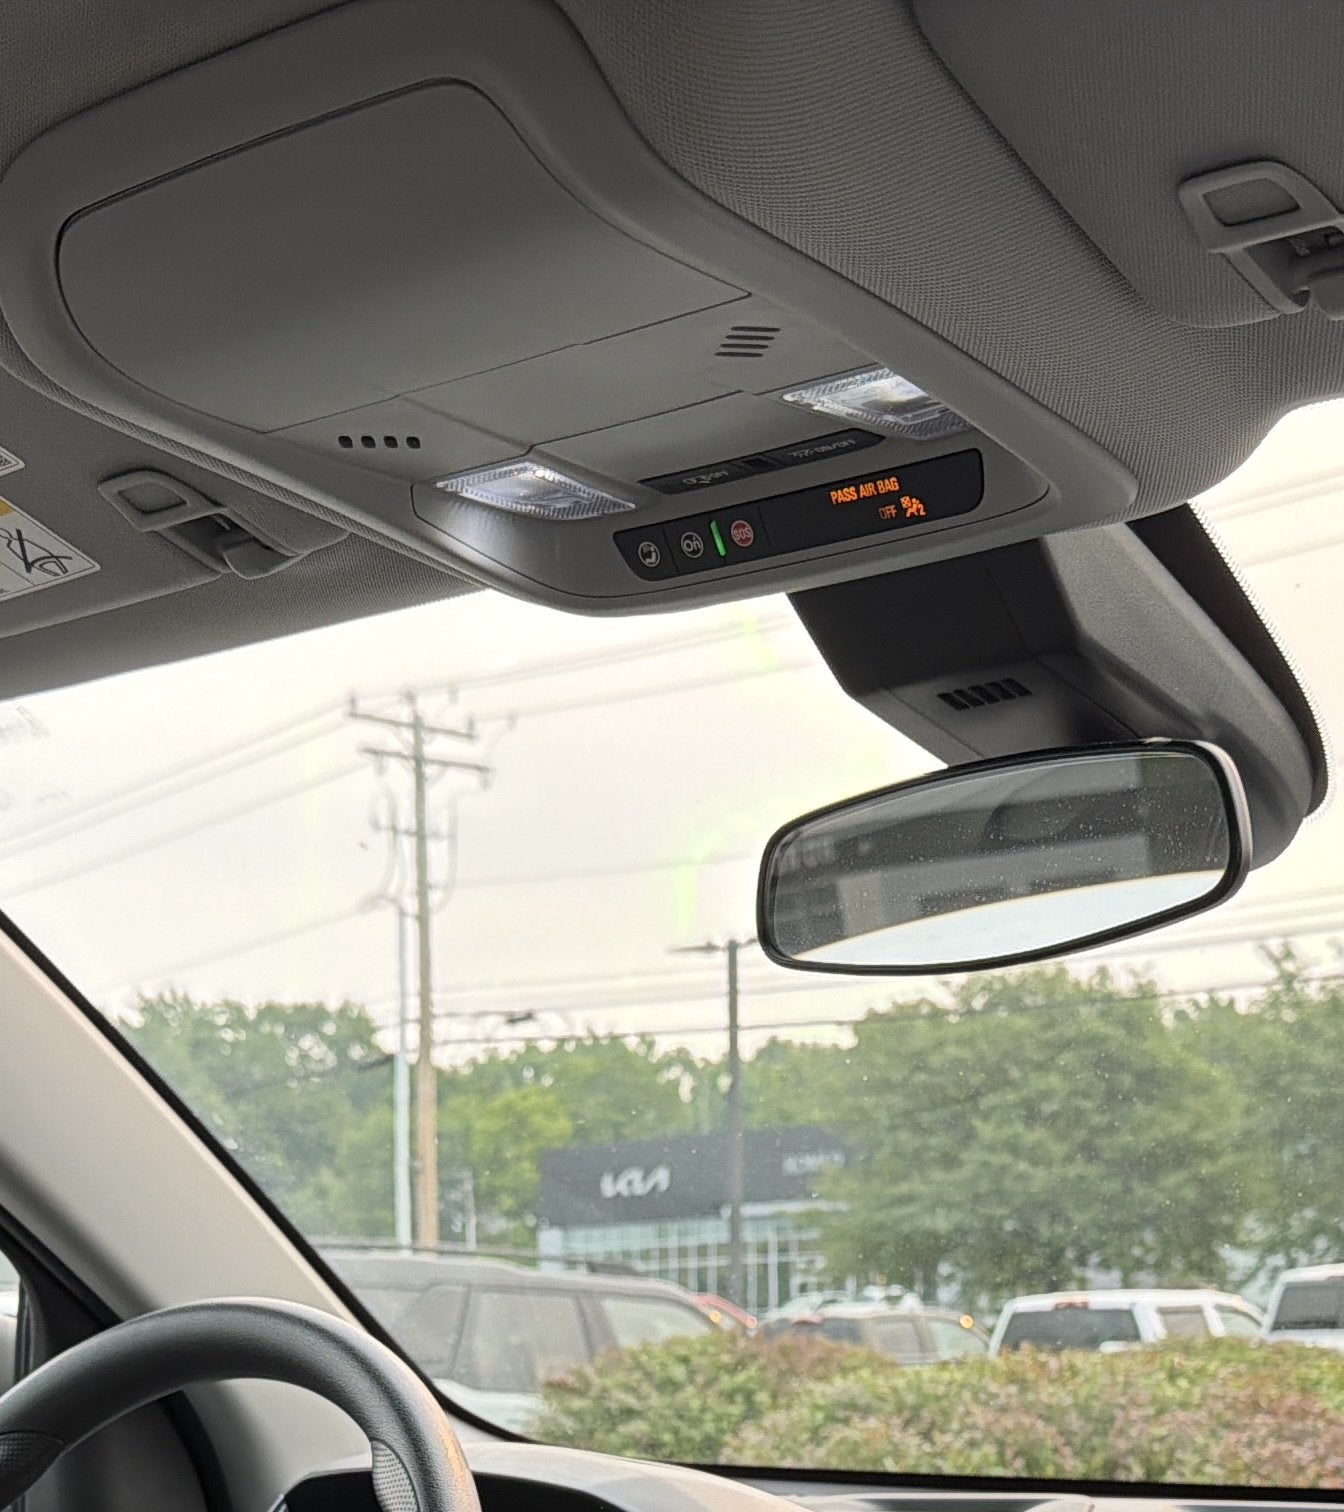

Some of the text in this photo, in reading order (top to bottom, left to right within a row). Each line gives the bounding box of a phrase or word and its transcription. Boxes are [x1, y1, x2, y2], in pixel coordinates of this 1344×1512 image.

[830, 476, 900, 505] PASS AIR BAG
[878, 504, 897, 520] OFF
[599, 1164, 671, 1199] KIA
